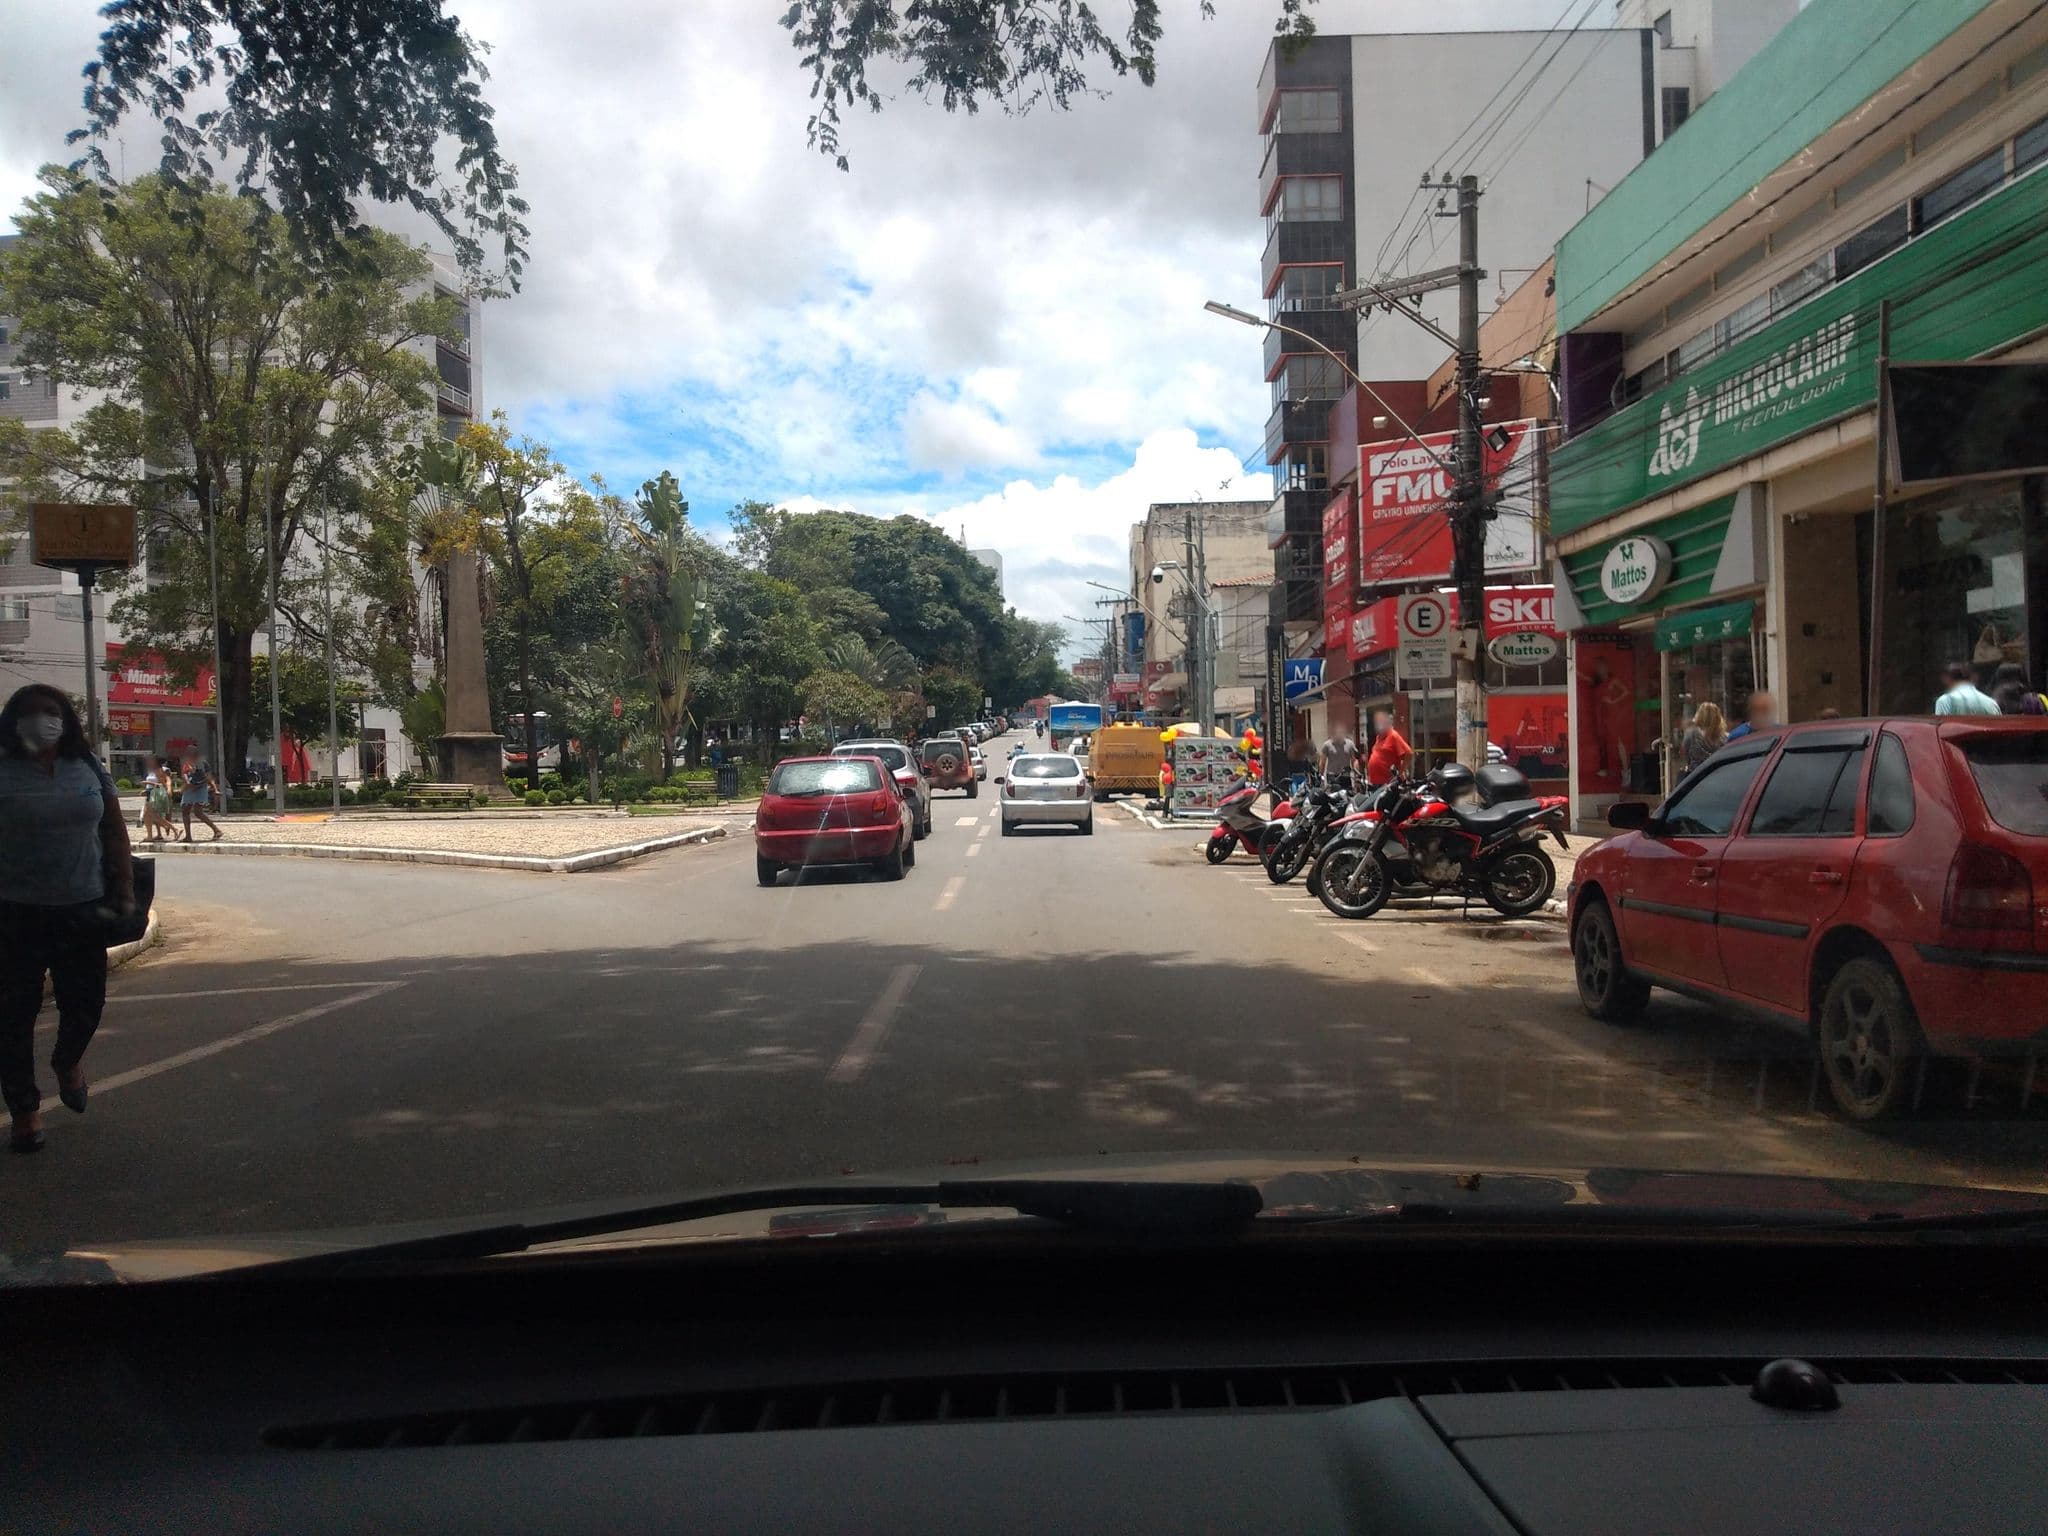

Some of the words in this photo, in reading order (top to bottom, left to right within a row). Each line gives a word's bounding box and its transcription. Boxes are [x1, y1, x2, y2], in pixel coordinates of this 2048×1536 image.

[1382, 457, 1408, 468] Polo
[1611, 566, 1647, 589] Mattos
[1418, 607, 1431, 628] E
[1489, 597, 1555, 622] SKI
[1503, 646, 1550, 655] Mattos
[1272, 649, 1281, 702] Guadalupe
[1274, 705, 1283, 751] Travessa
